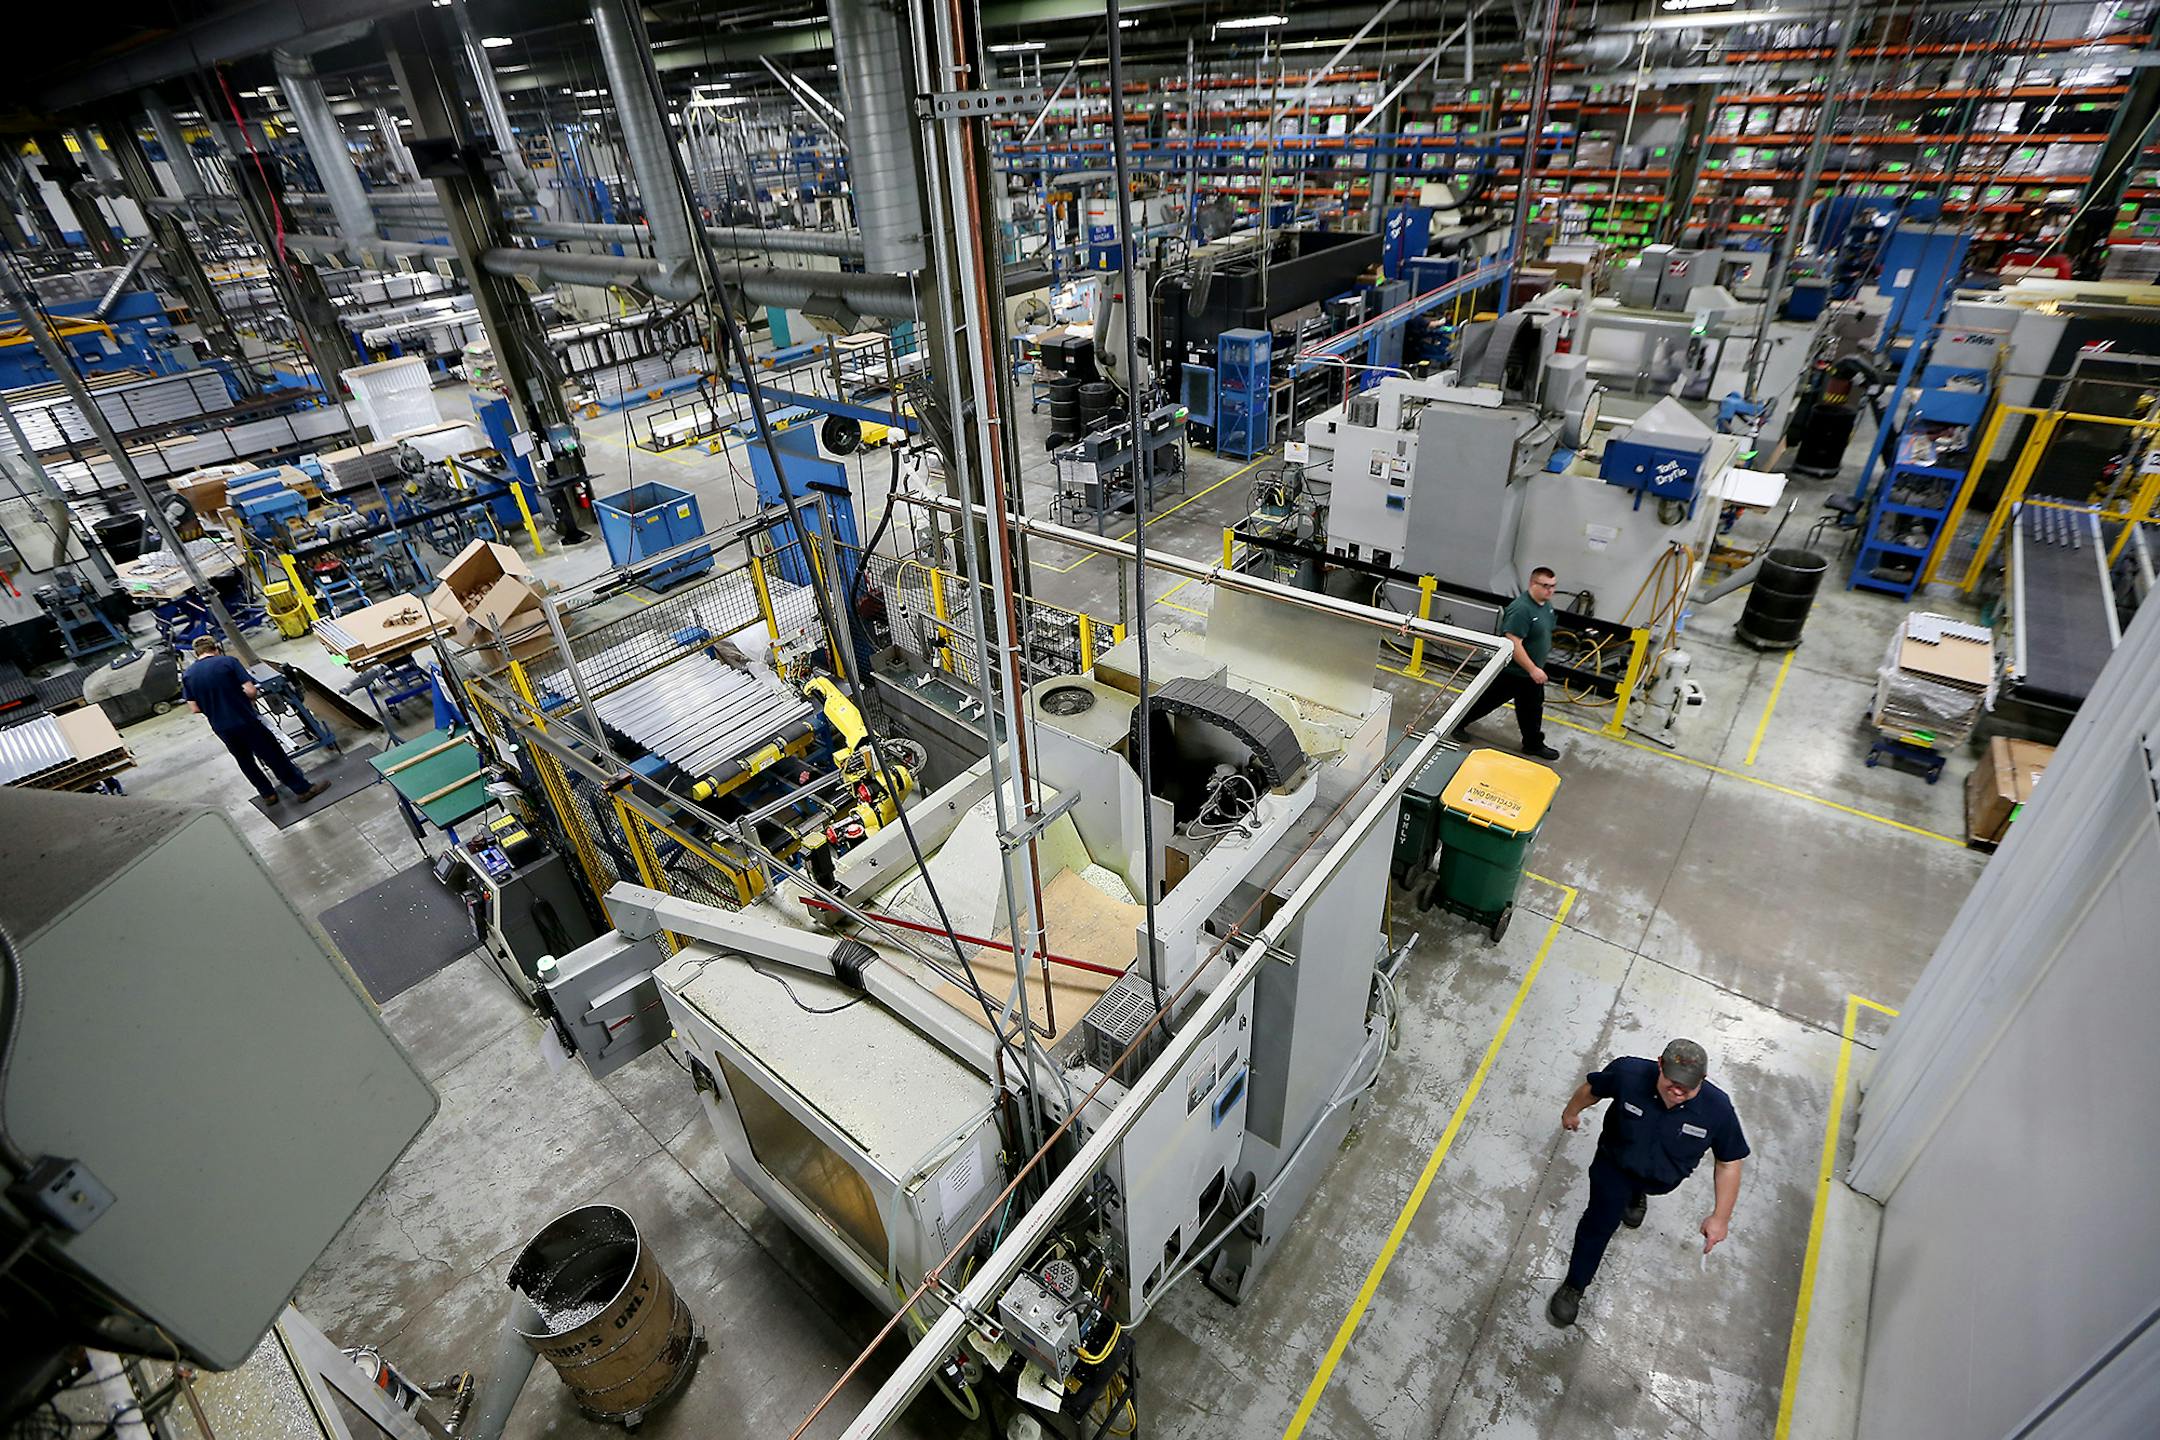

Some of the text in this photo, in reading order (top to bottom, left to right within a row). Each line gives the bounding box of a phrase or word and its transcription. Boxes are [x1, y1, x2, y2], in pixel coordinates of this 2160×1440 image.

[1468, 786, 1521, 811] RECYCLING ONLY
[1400, 813, 1411, 844] ONLY
[614, 1277, 650, 1329] ONLY
